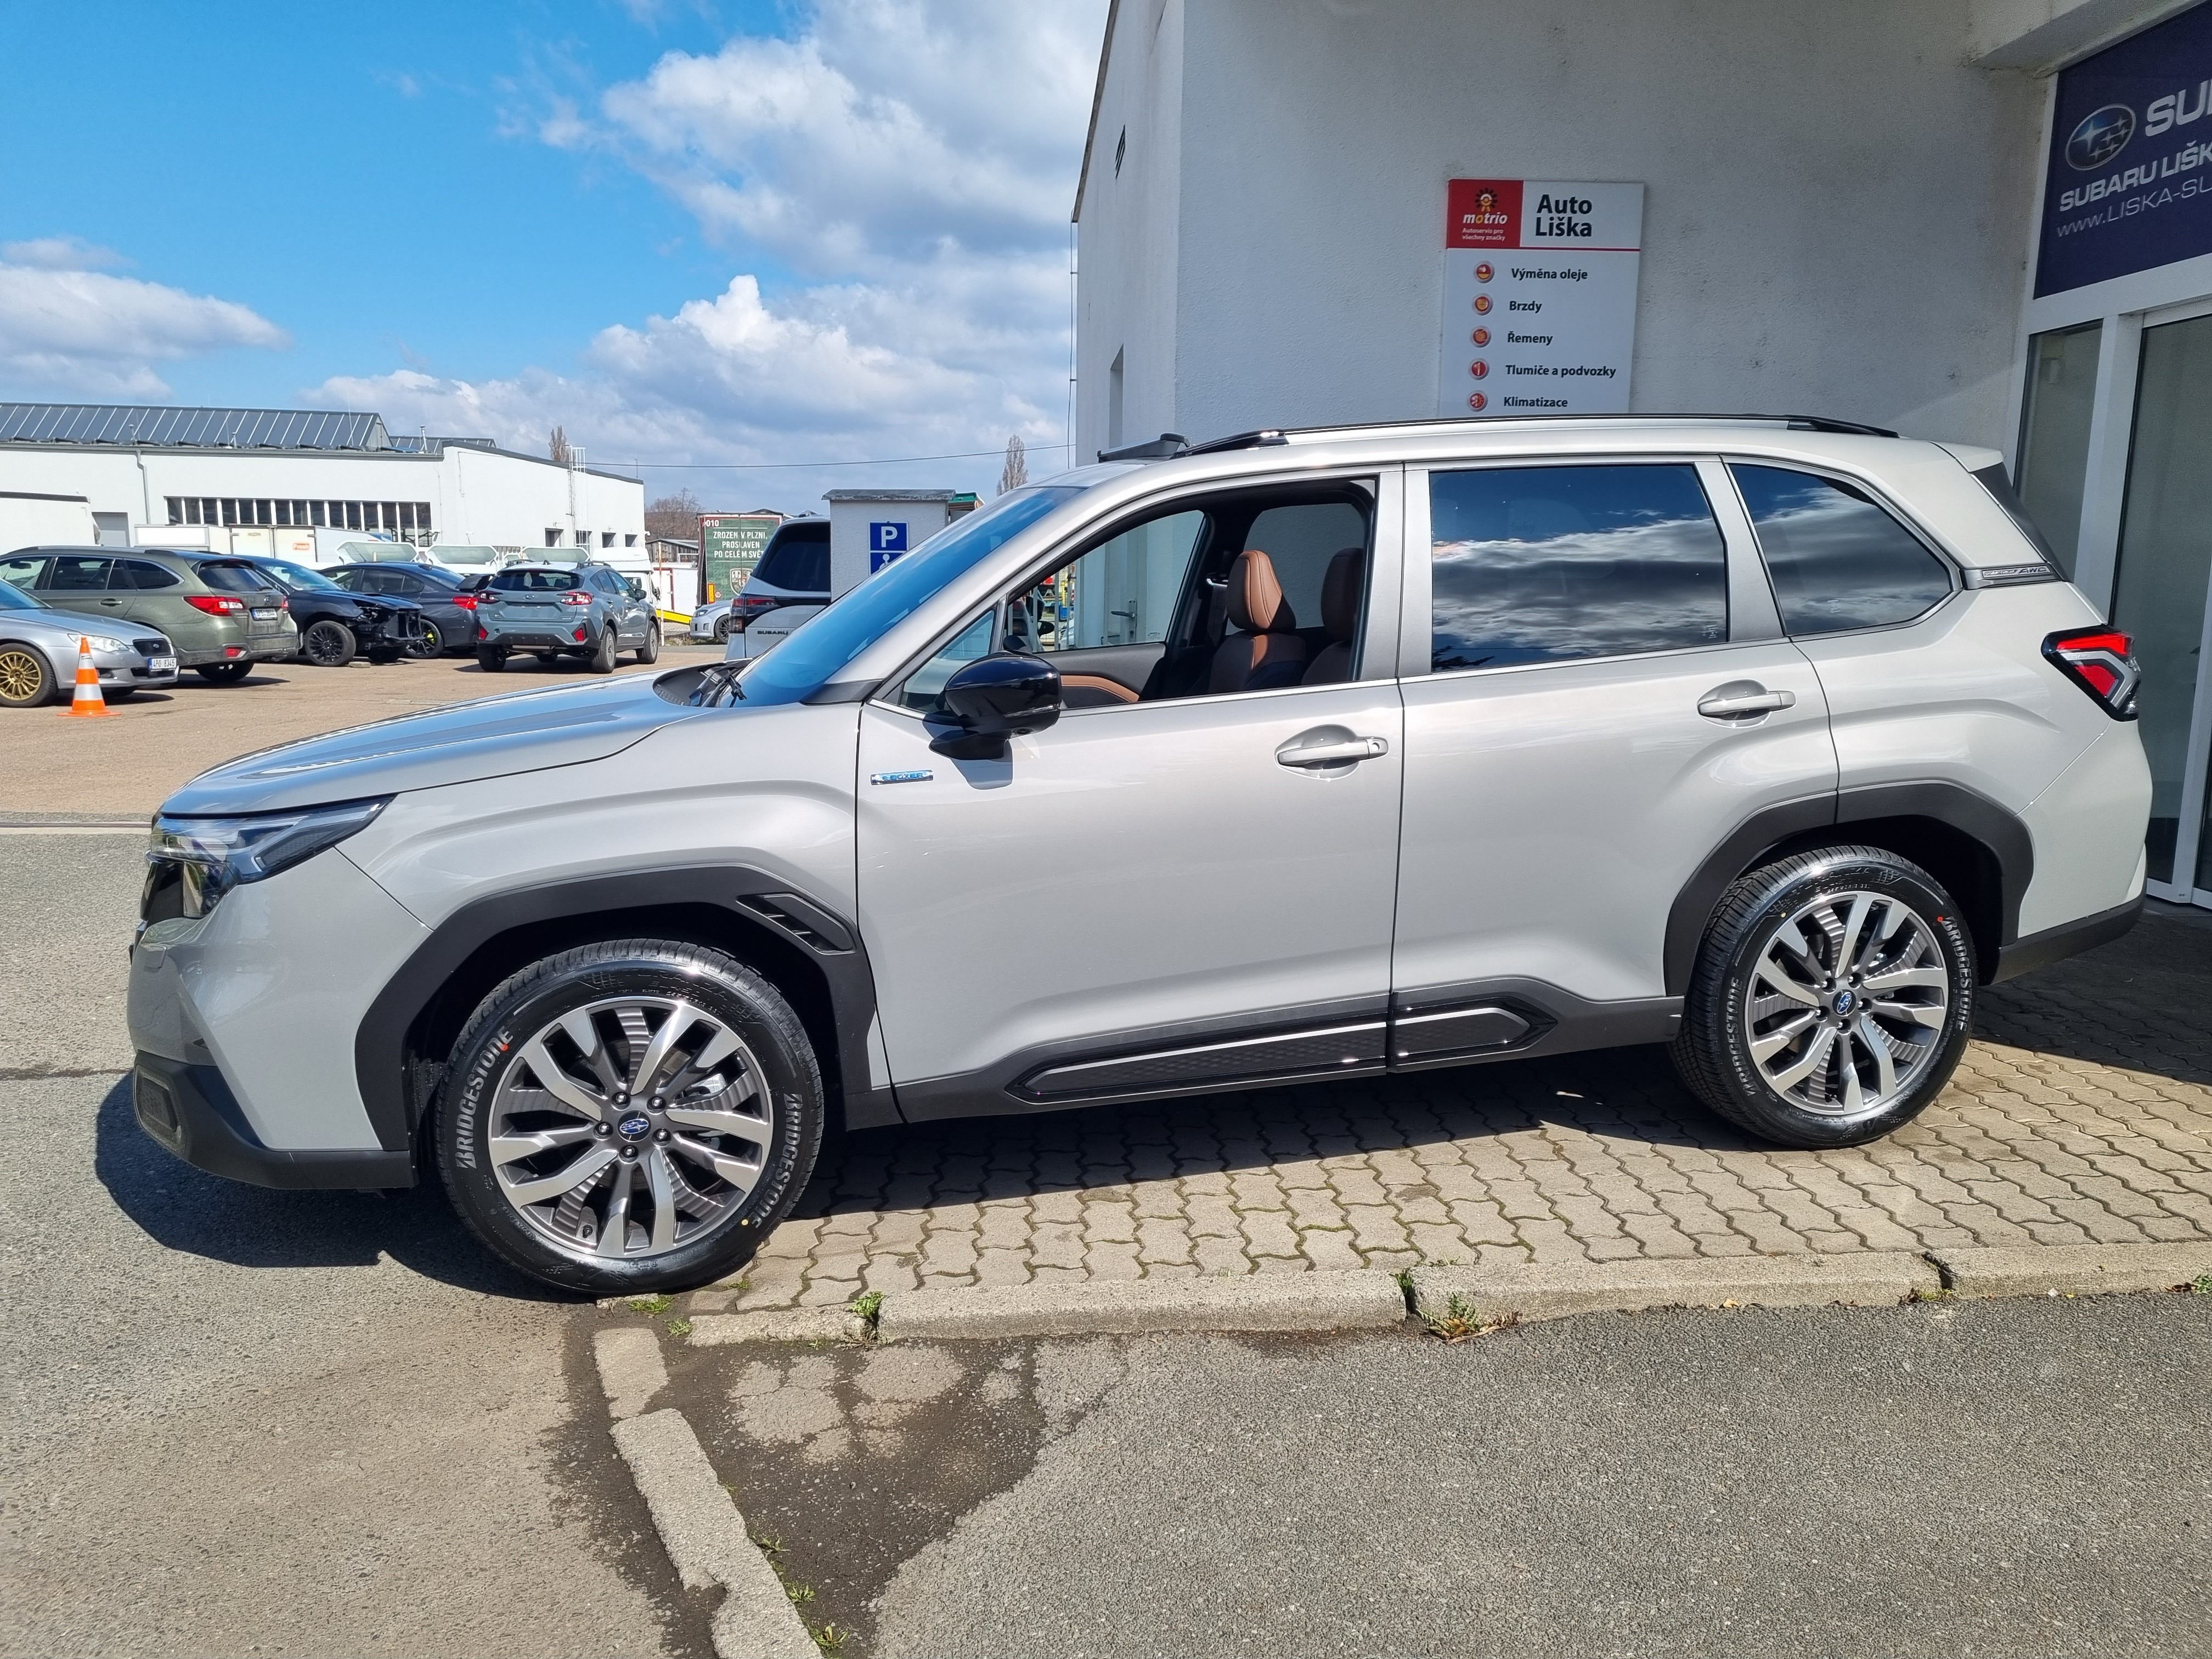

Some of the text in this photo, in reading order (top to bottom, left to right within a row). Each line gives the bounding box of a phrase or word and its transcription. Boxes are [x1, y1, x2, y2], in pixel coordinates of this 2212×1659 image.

[2060, 161, 2157, 212] SUBARU
[1537, 194, 1593, 215] Auto
[1463, 212, 1508, 224] motrio
[1536, 217, 1593, 237] Liška
[1511, 268, 1588, 281] Výměna oleje
[1509, 301, 1543, 313] Brzdy
[1508, 331, 1553, 346] Řemeny
[1505, 364, 1549, 376] Tlumiče
[1561, 365, 1616, 379] podvozky
[1504, 396, 1568, 408] Klimatizace
[747, 531, 768, 539] PLZNI,
[881, 526, 898, 548] P
[725, 549, 747, 558] CELÉM
[1943, 916, 1972, 1032] BRIDGESTONE
[1726, 977, 1762, 1097] BRIDGESTONE
[455, 1025, 514, 1169] BRIDGESTONE
[748, 1093, 803, 1229] BRIDGESTONE
